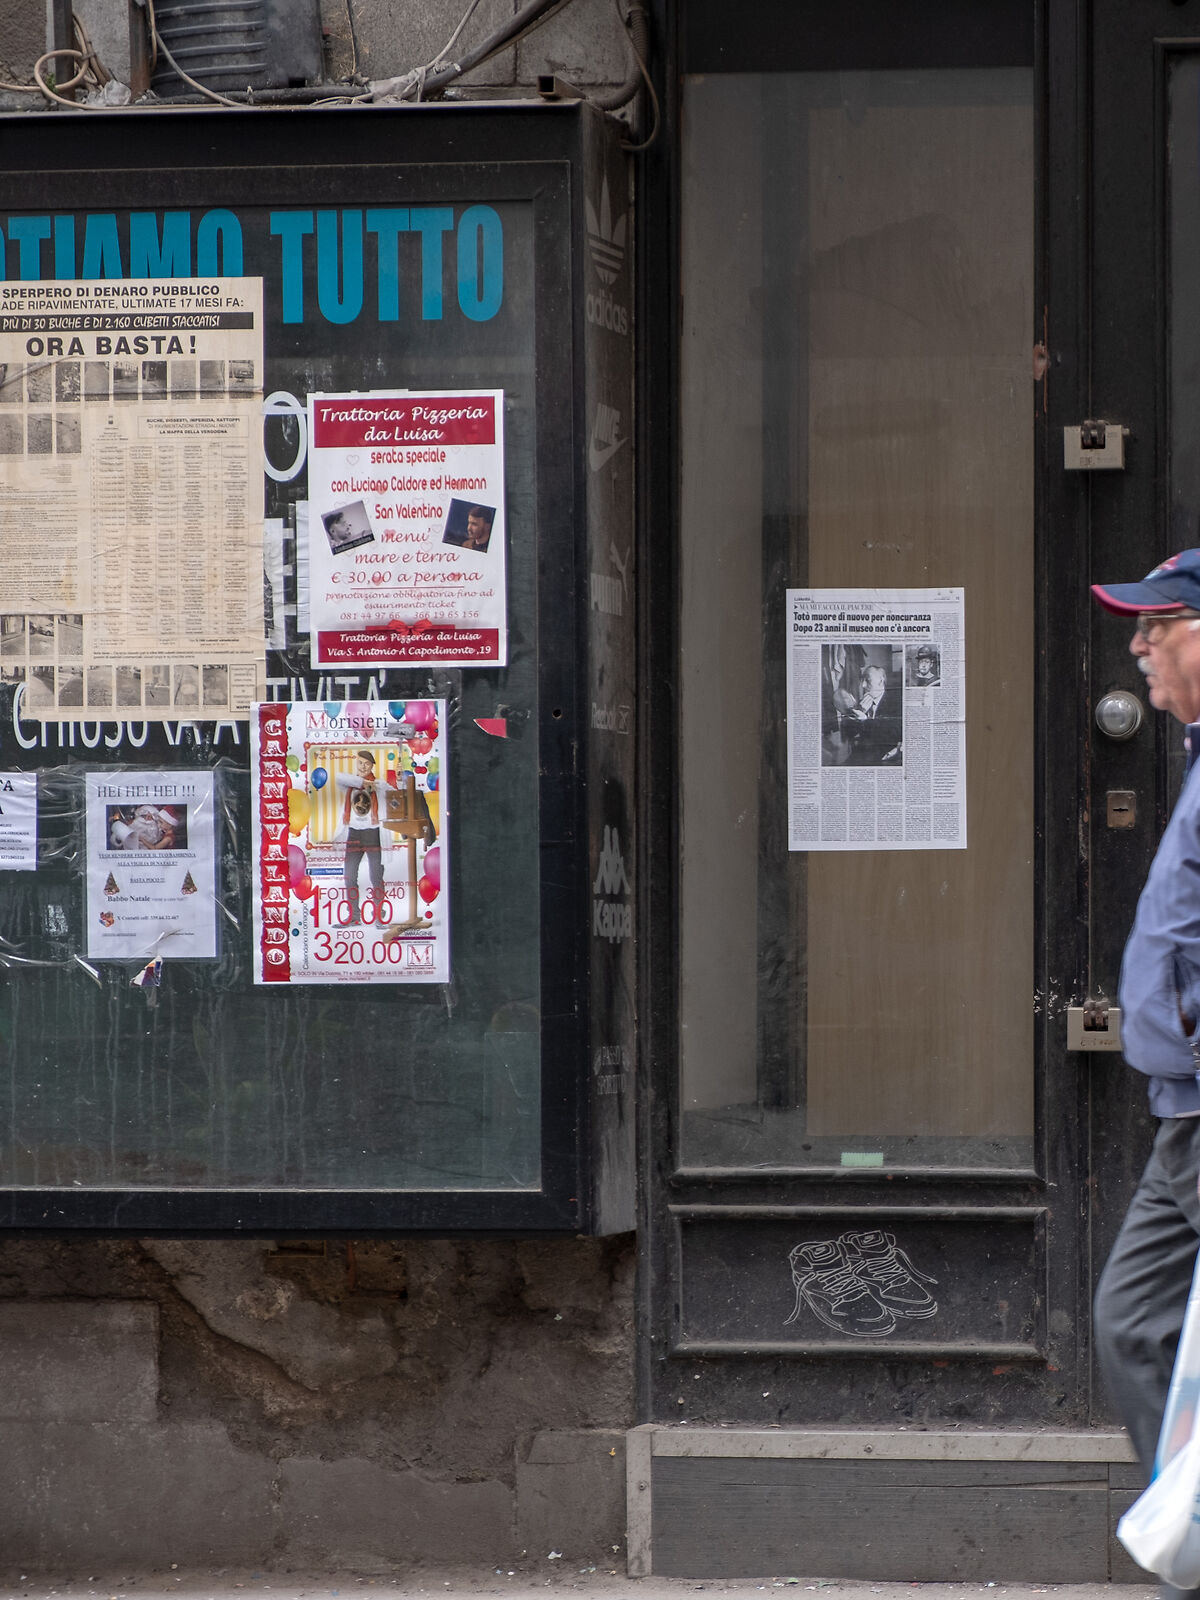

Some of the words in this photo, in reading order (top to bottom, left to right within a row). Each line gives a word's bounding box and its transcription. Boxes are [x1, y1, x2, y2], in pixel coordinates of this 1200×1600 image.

[0, 208, 243, 280] TIAMO
[270, 206, 503, 324] TUTTO
[3, 288, 72, 298] SPERPERO
[77, 287, 89, 297] DI
[95, 287, 148, 297] DENARO
[153, 286, 219, 296] PUBBLICO
[28, 300, 118, 310] RIPAVIMENTATE,
[122, 299, 176, 308] ULTIMATE
[180, 299, 191, 308] 17
[196, 298, 222, 308] MESI
[226, 298, 243, 307] FA:
[587, 289, 628, 336] adidas
[3, 315, 18, 330] PIÙ
[22, 319, 32, 329] DI
[34, 318, 45, 329] 30
[49, 318, 81, 329] BUCHE
[84, 318, 90, 328] E
[93, 317, 102, 328] DI
[105, 317, 130, 328] 2.160
[133, 316, 168, 327] CUBETTI
[172, 315, 219, 327] STACCATISI
[26, 337, 85, 356] ORA
[320, 407, 405, 422] Trattoria
[412, 406, 488, 425] Pizzeria
[364, 427, 391, 441] da
[395, 426, 443, 441] Luisa
[371, 450, 403, 464] serata
[406, 448, 446, 466] speciale
[331, 480, 348, 492] con
[351, 477, 388, 492] Luciano
[391, 477, 427, 491] Caldore
[430, 475, 441, 490] ed
[445, 475, 486, 490] Hermann
[375, 504, 394, 519] San
[397, 503, 442, 519] Valentino
[381, 528, 431, 543] menu'
[355, 553, 400, 564] mare
[403, 553, 413, 563] e
[416, 551, 460, 563] terra
[331, 572, 341, 584] €
[347, 571, 391, 585] 30,00
[398, 573, 410, 582] a
[413, 571, 484, 586] persona
[794, 612, 810, 621] Totò
[812, 613, 836, 621] muore
[838, 612, 845, 621] di
[847, 613, 869, 621] nuovo
[871, 613, 884, 623] per
[886, 613, 931, 621] noncuranza
[793, 624, 812, 634] Dopo
[814, 623, 823, 632] 23
[825, 623, 841, 632] anni
[842, 623, 847, 632] il
[890, 623, 902, 632] c'è
[306, 710, 388, 730] Morisieri
[98, 786, 121, 798] HEI
[126, 786, 149, 797] HEI
[154, 785, 177, 797] HEI
[182, 785, 195, 797] !!!
[260, 719, 288, 965] CARNEVALANDO
[319, 887, 359, 900] FOTO
[322, 900, 393, 925] 10.00
[593, 899, 632, 944] Kappa
[337, 931, 364, 940] FOTO
[314, 932, 332, 961] 3
[334, 942, 402, 964] 20.00
